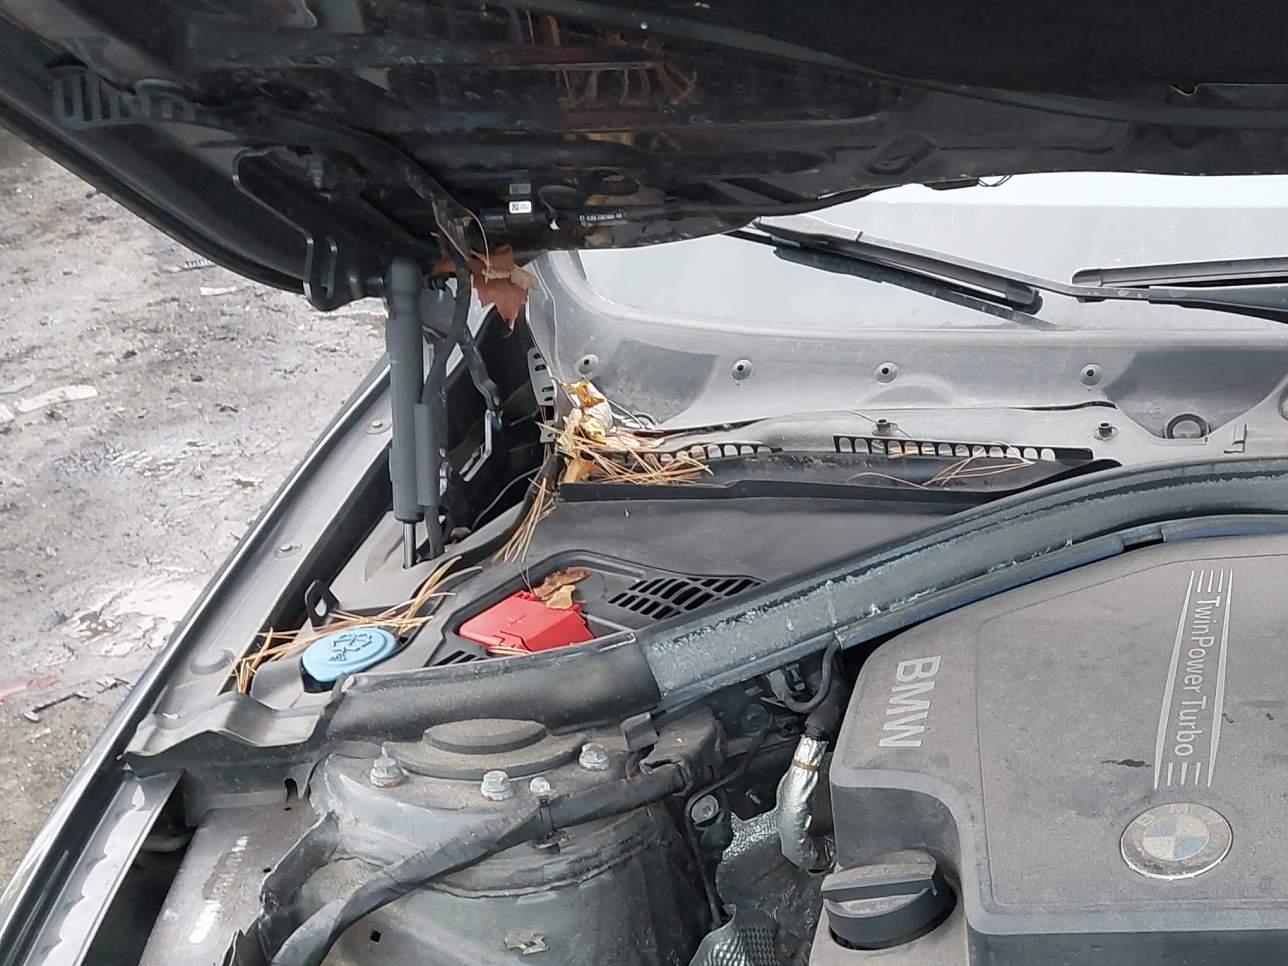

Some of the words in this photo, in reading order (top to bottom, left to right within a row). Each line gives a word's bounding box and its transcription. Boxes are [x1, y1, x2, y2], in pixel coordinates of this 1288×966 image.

[1183, 595, 1221, 693] TwinPower
[878, 654, 942, 748] BMW
[1174, 695, 1207, 757] Turbo
